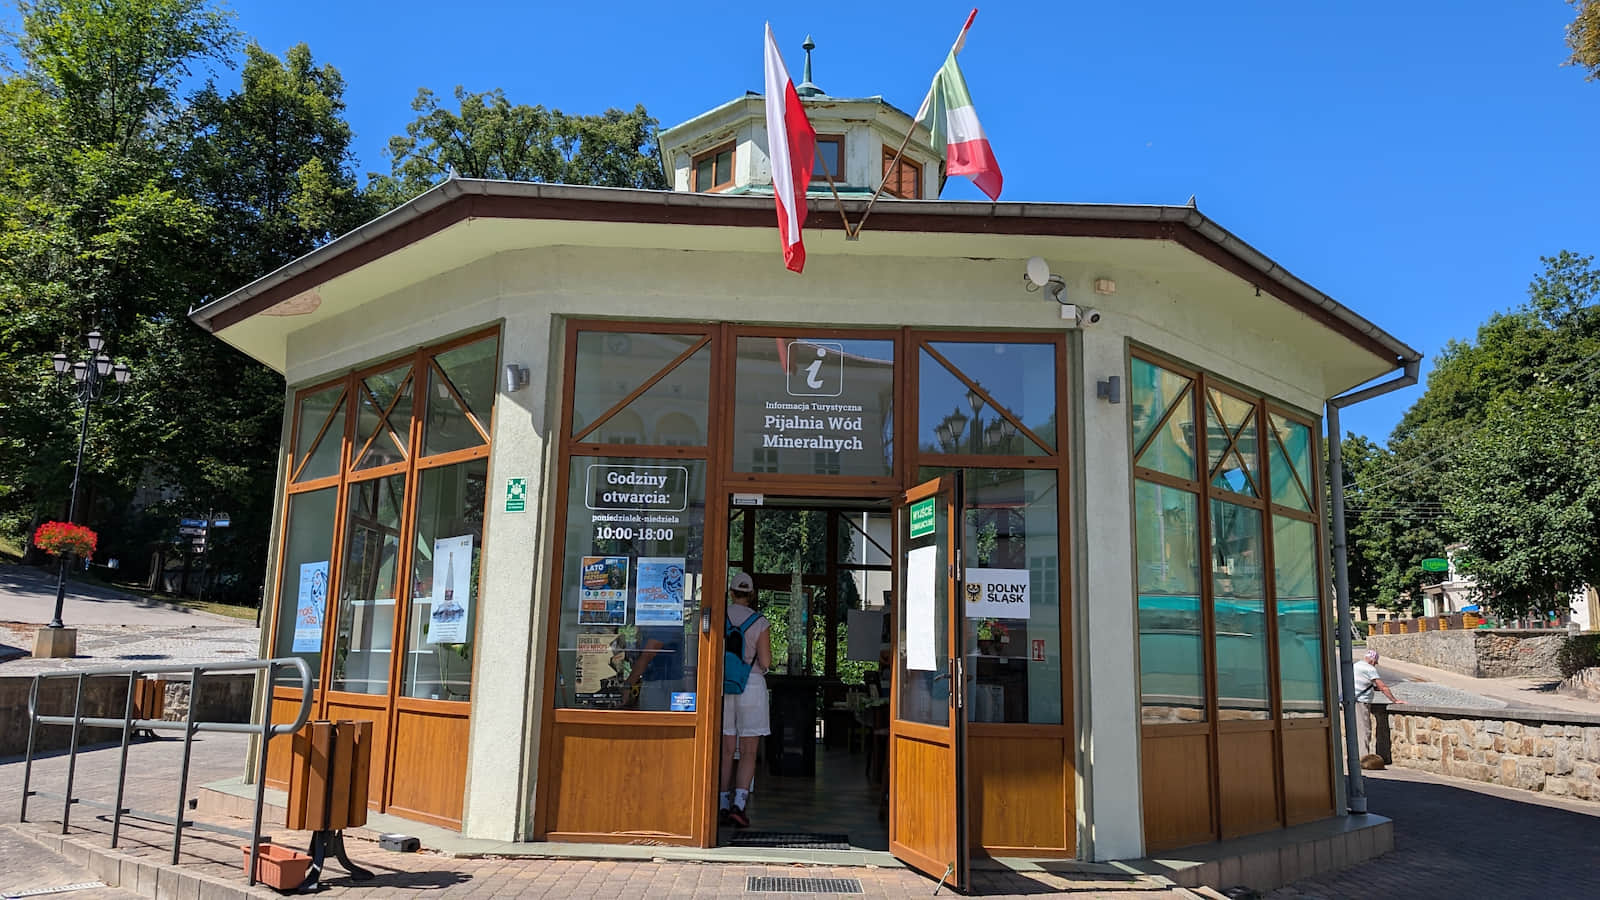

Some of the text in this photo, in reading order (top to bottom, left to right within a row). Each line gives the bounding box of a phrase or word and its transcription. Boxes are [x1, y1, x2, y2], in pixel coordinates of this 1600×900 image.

[765, 401, 863, 412] Informacja Turystyczna
[764, 415, 863, 432] Pijalnia Wód
[762, 434, 863, 453] Mineralnych
[607, 471, 668, 489] Godziny
[602, 490, 671, 504] otwarcia:
[596, 526, 674, 541] 10:00-18:00
[584, 563, 604, 572] LATO
[987, 583, 1027, 593] DOLNY
[987, 592, 1025, 605] ŚLĄSK
